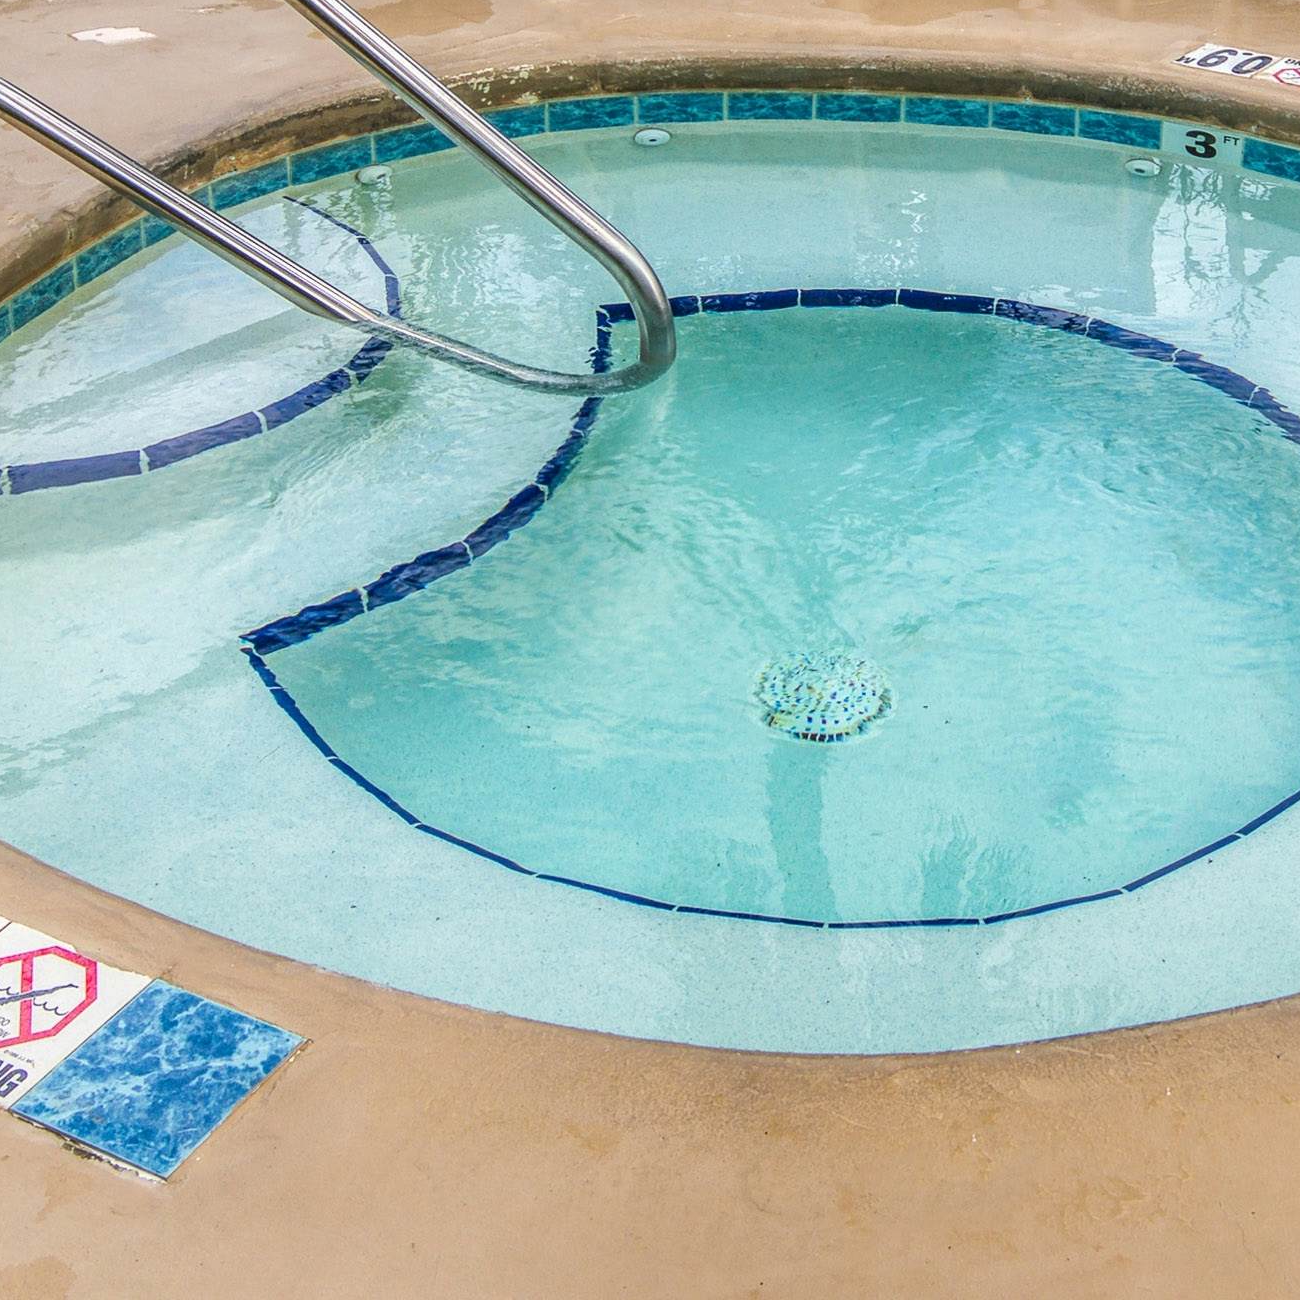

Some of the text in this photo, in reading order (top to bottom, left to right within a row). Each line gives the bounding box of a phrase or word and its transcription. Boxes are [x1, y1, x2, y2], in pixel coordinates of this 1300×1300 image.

[1197, 49, 1273, 74] 0.9
[1184, 129, 1240, 159] 3 FT
